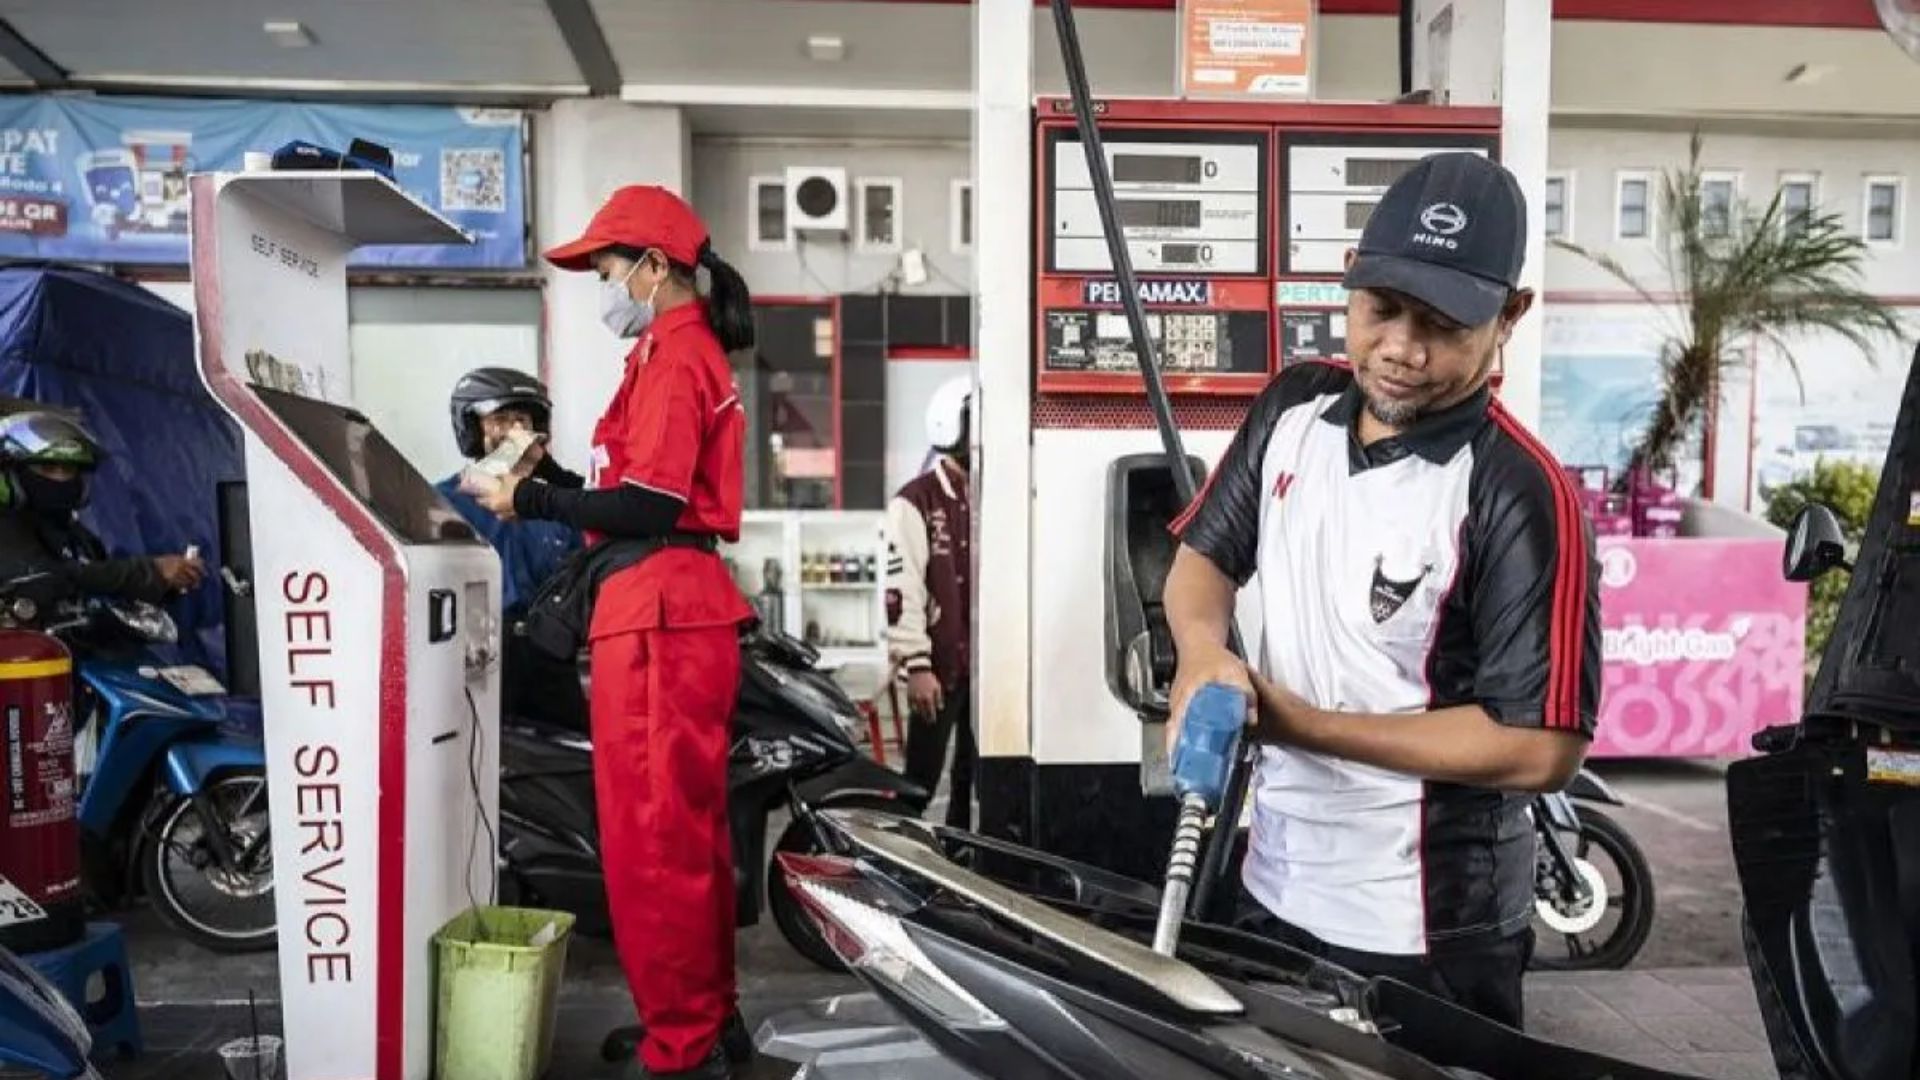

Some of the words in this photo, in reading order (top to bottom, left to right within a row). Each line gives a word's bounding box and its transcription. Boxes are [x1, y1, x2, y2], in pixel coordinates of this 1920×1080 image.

[1413, 232, 1459, 249] HINO
[1089, 280, 1206, 303] PEAMAX
[282, 570, 335, 710] SELF
[294, 743, 353, 984] SERVICE
